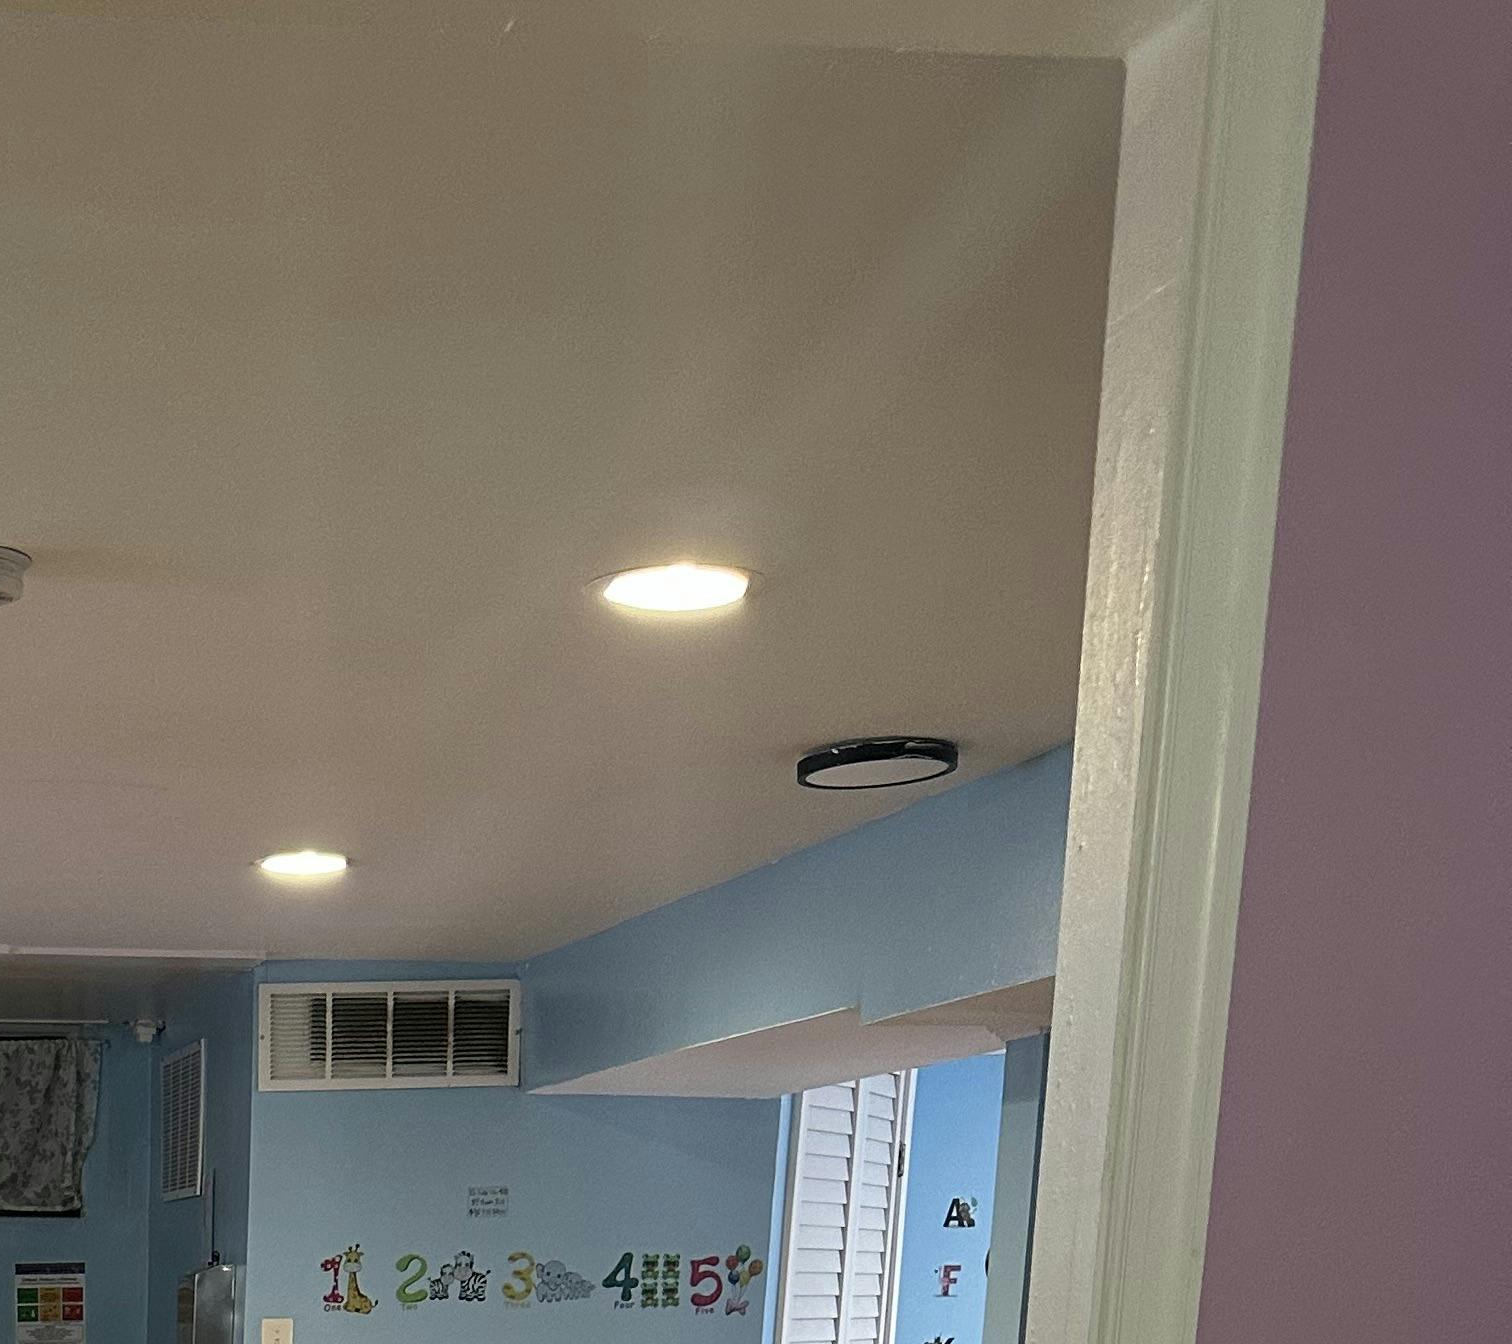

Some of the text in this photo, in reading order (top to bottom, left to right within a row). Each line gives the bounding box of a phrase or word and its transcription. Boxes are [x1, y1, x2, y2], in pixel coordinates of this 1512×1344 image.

[320, 1254, 345, 1303] 1
[396, 1253, 428, 1303] 2
[502, 1252, 536, 1301] 3
[602, 1252, 639, 1301] 4
[690, 1256, 723, 1306] 5
[939, 1265, 962, 1297] F
[614, 1300, 635, 1310] Four
[695, 1306, 715, 1315] Five
